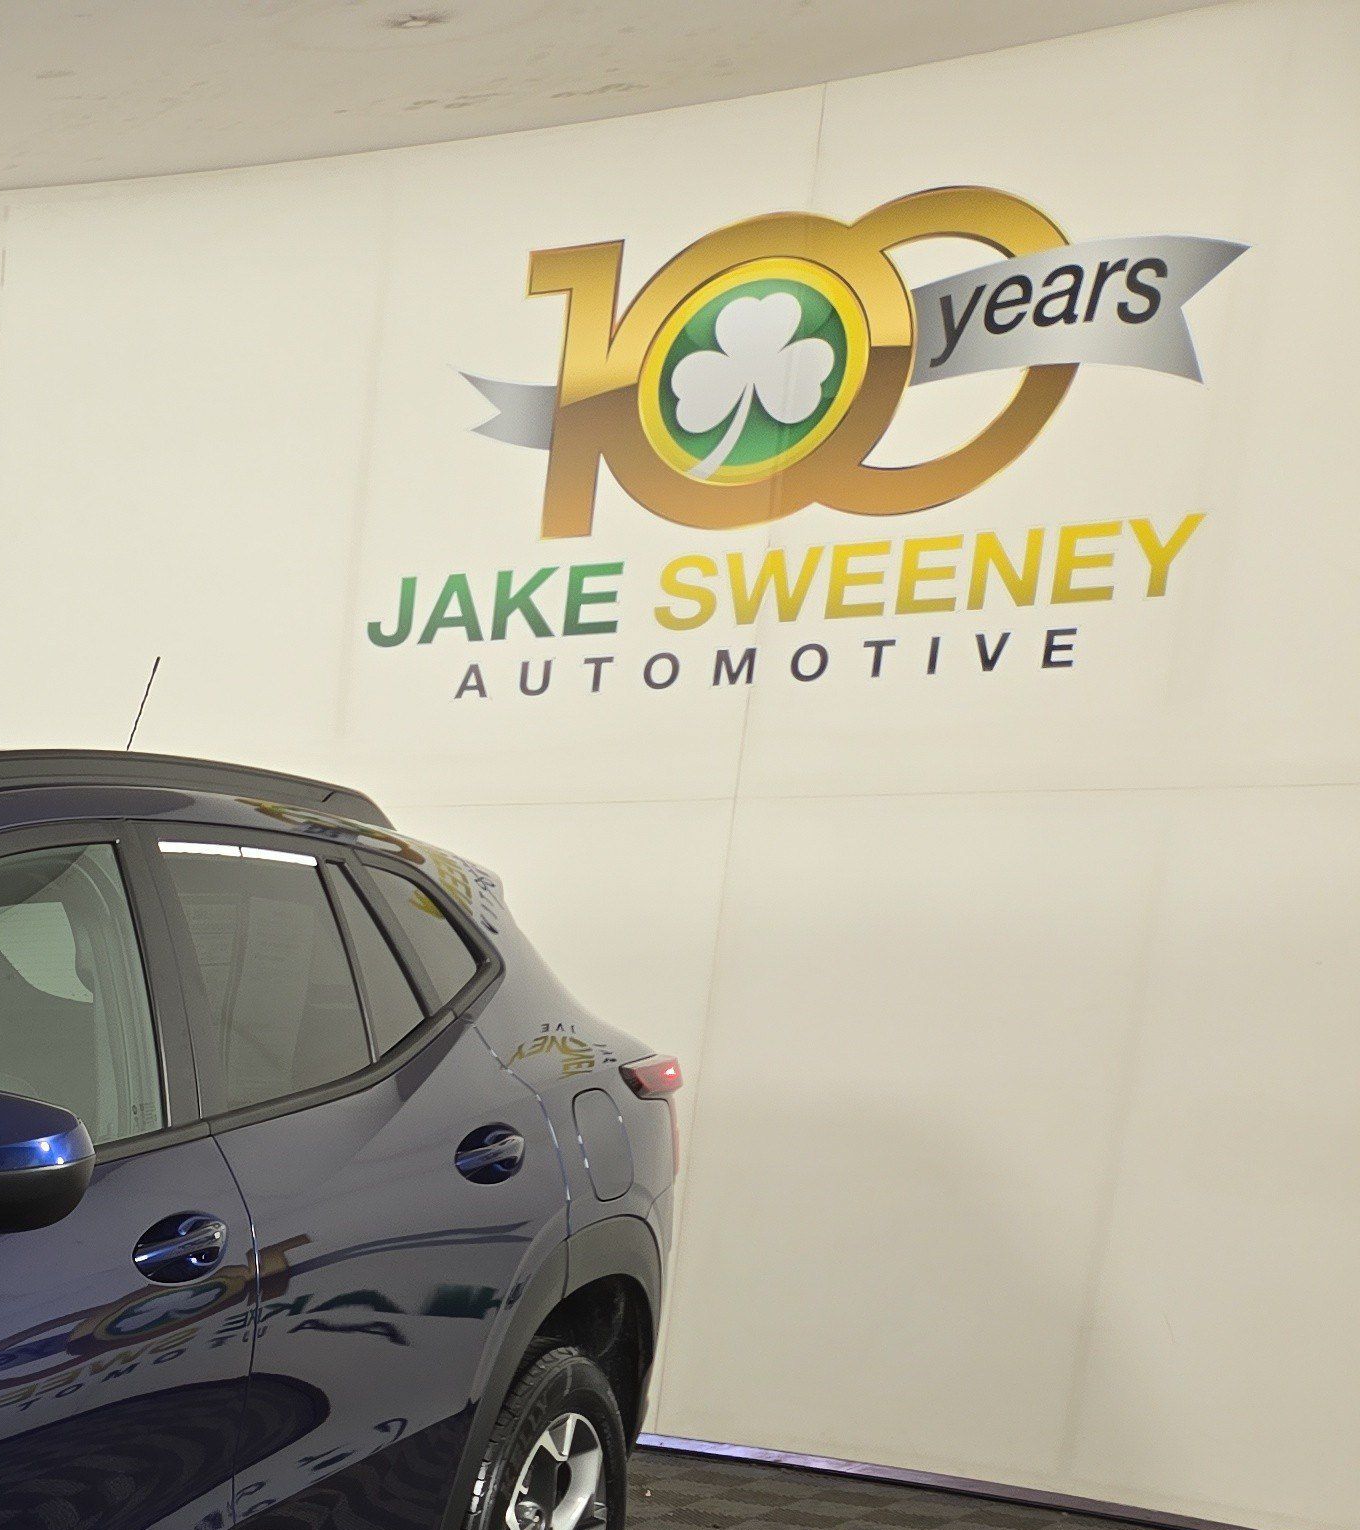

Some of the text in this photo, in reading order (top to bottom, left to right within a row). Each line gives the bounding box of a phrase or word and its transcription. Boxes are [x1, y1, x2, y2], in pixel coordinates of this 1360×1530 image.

[927, 255, 1168, 369] years
[366, 513, 1205, 648] JAKE SWEENEY
[455, 628, 1079, 700] AUTOMOTIVE
